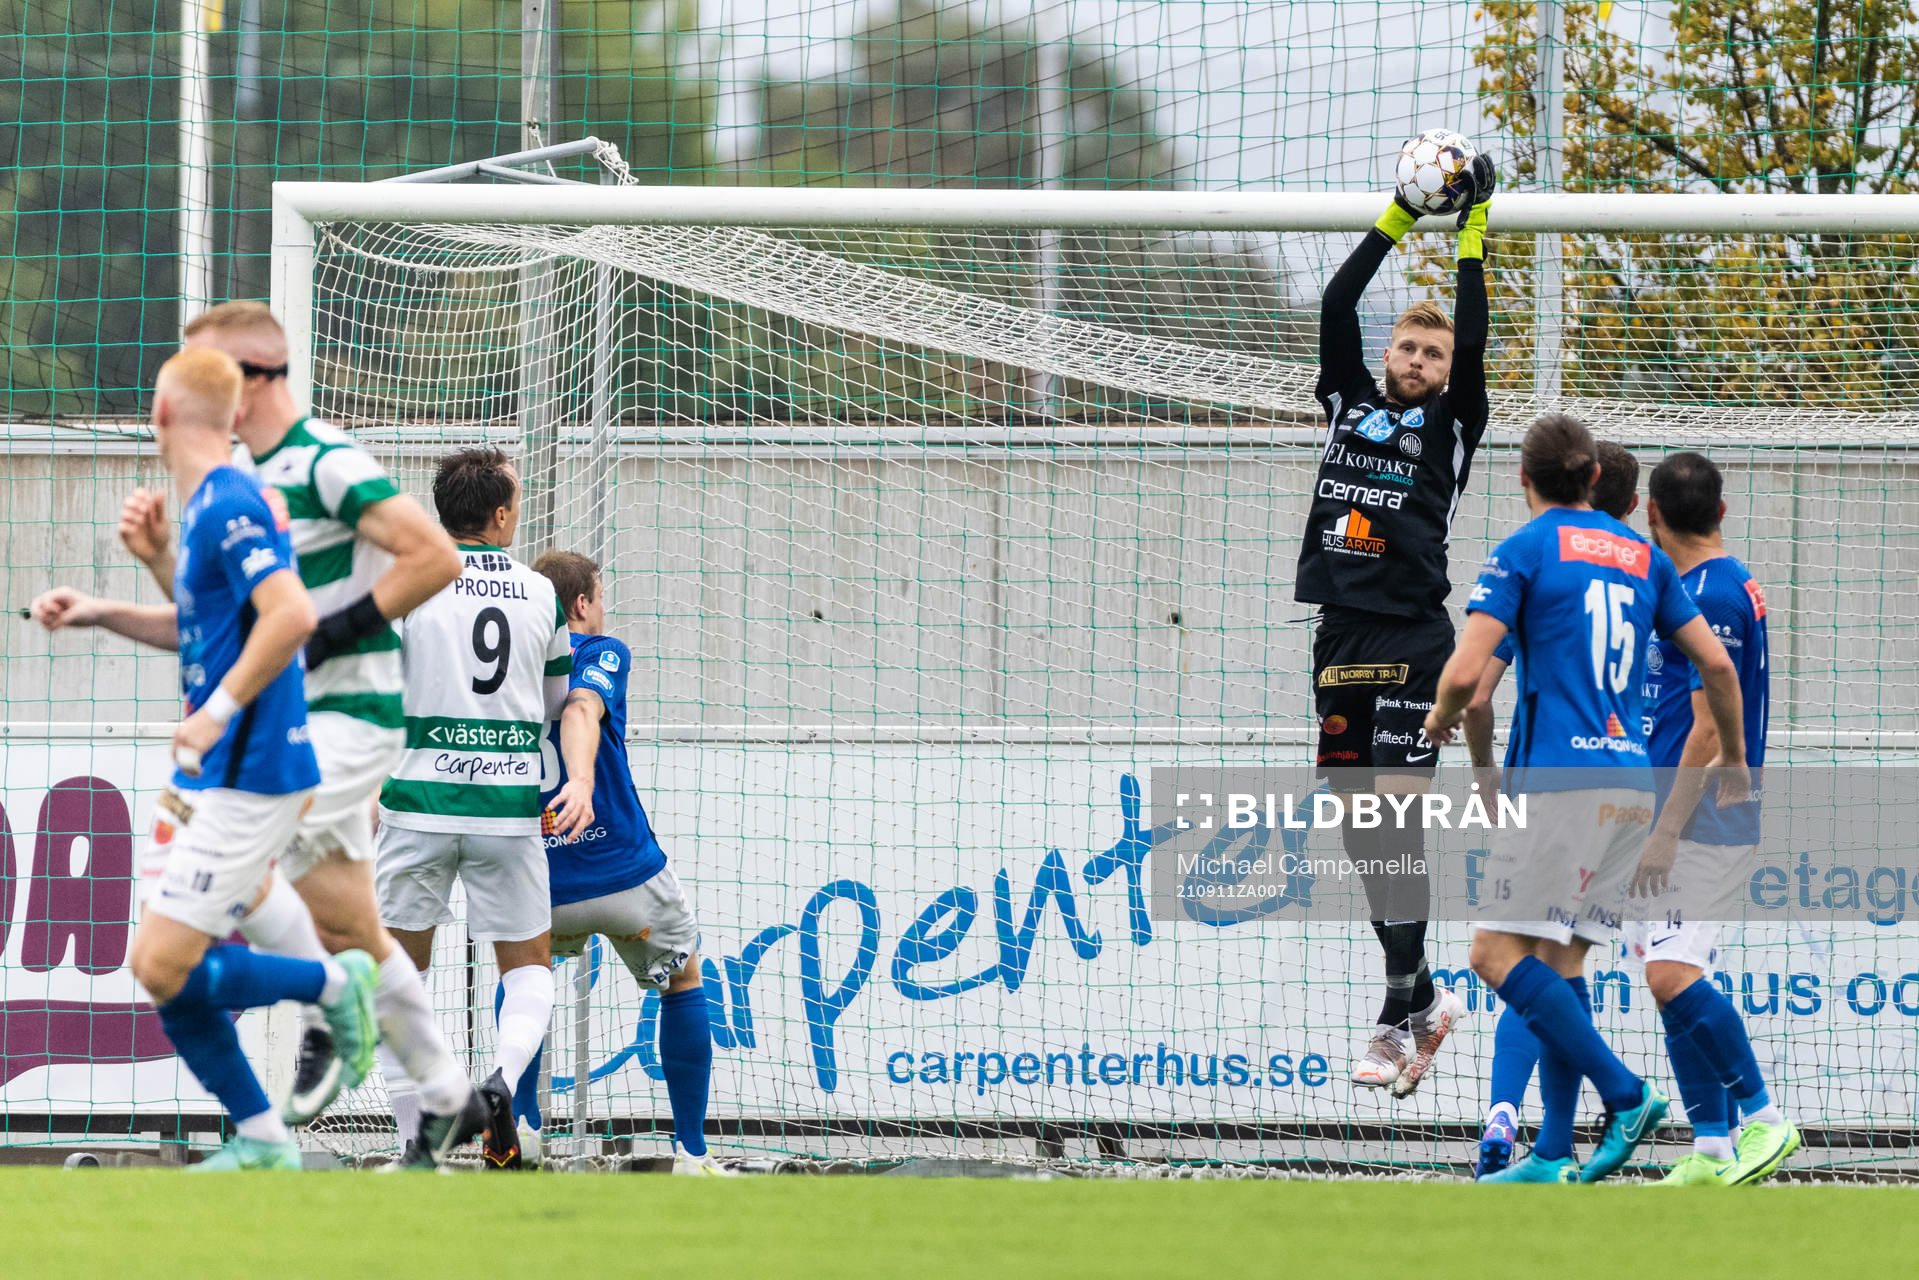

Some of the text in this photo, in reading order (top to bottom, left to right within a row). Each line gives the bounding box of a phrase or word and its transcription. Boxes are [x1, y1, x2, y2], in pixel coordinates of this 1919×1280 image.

[1345, 452, 1417, 478] KONTAKT
[1319, 479, 1404, 510] Cernera
[465, 554, 513, 572] ABB
[455, 577, 528, 600] PRODELL
[1585, 578, 1634, 694] 15
[472, 606, 511, 695] 9
[1495, 878, 1511, 900] 15
[1666, 908, 1682, 930] 14
[886, 1042, 1329, 1096] carpenterhus.se
